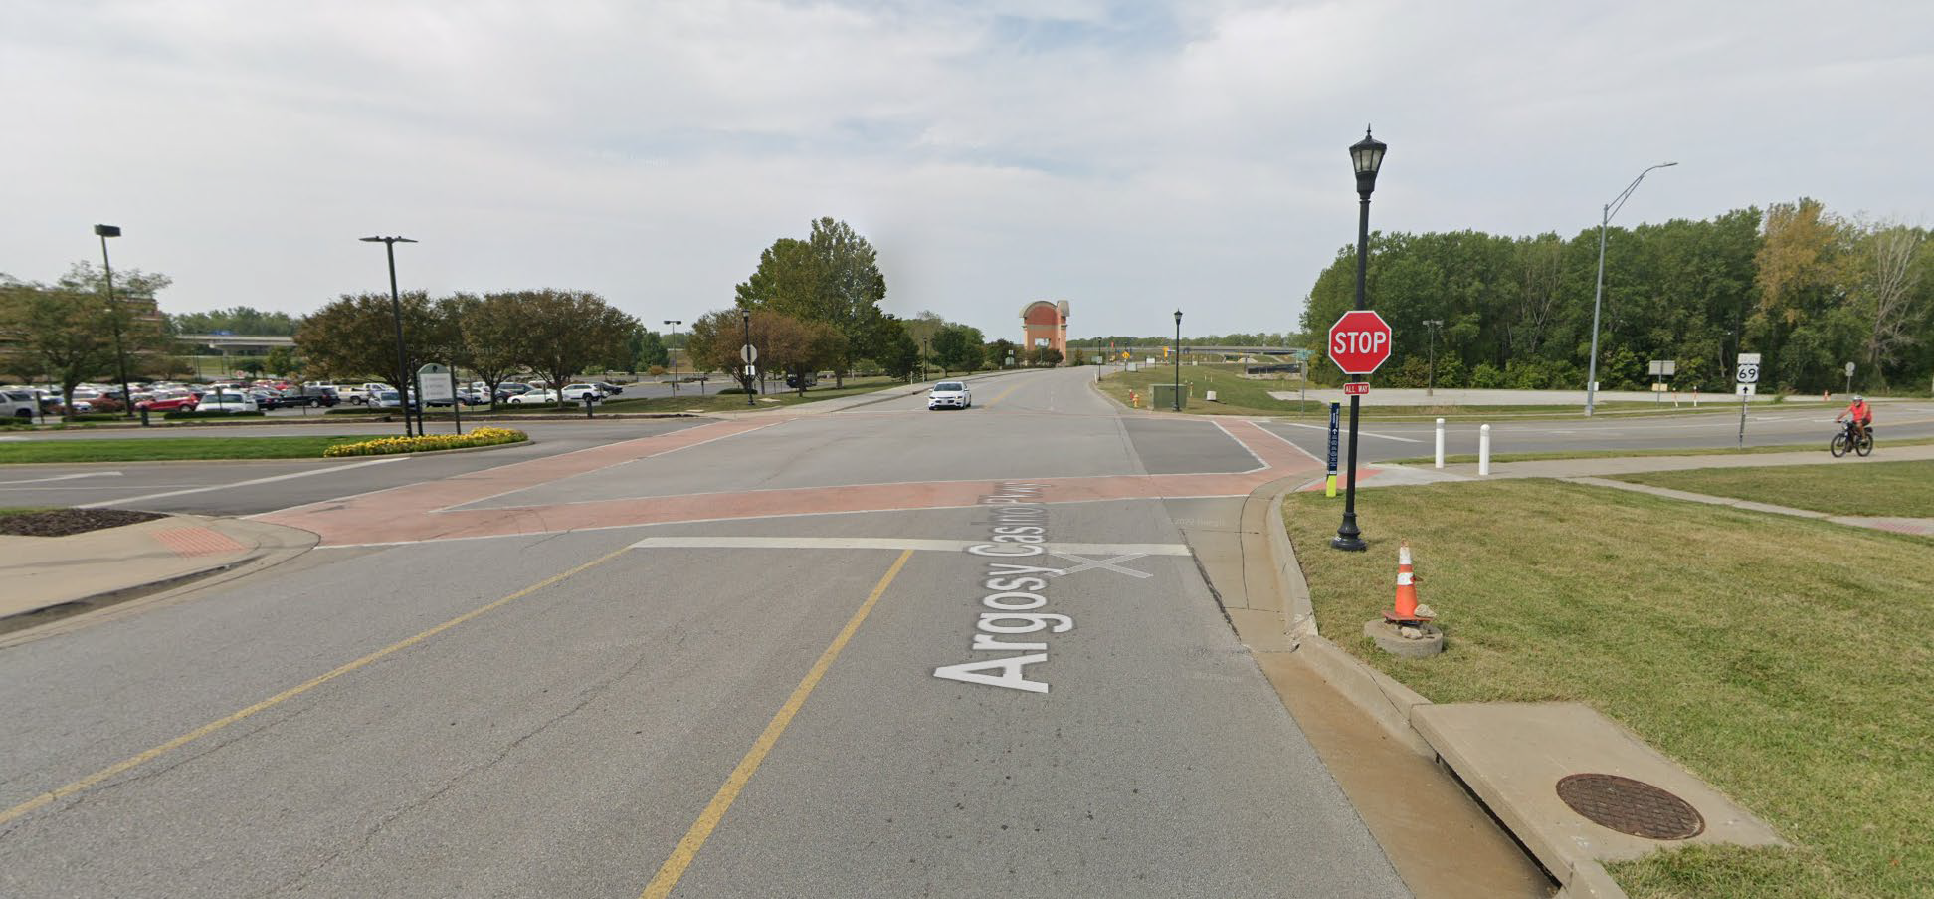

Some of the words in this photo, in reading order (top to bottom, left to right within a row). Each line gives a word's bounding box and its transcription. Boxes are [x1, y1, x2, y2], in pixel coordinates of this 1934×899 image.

[1333, 332, 1387, 354] STOP
[1739, 368, 1756, 379] 69
[1345, 385, 1356, 393] ALL
[1358, 385, 1369, 393] WAY
